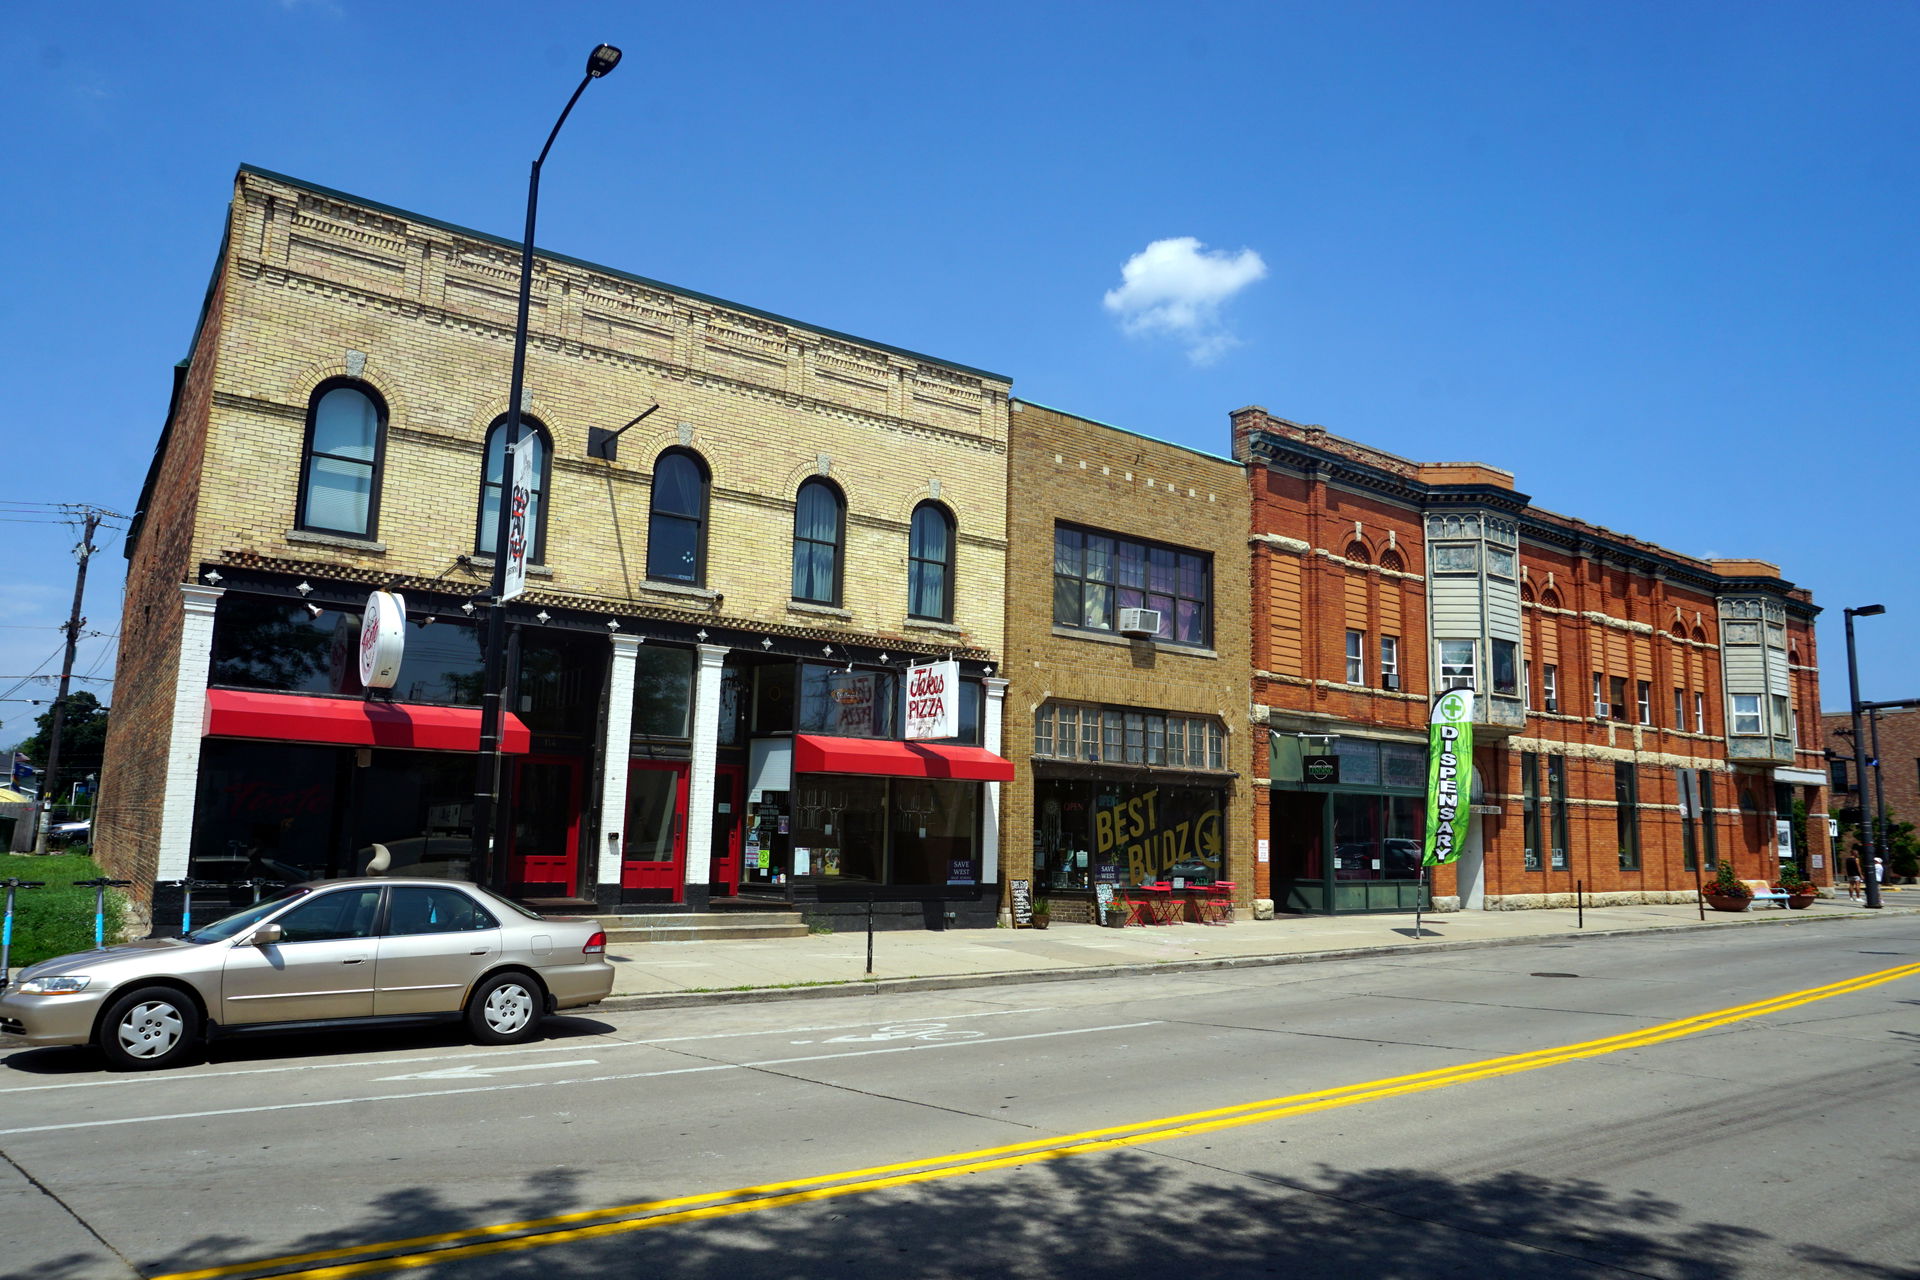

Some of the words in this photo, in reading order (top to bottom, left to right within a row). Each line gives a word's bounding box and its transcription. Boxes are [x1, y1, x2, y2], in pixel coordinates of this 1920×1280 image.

[908, 696, 945, 720] PIZZA
[910, 667, 945, 697] Jakes
[1096, 790, 1158, 853] BEST
[1435, 725, 1459, 861] DISPENSARY
[1128, 820, 1192, 886] BUDZ
